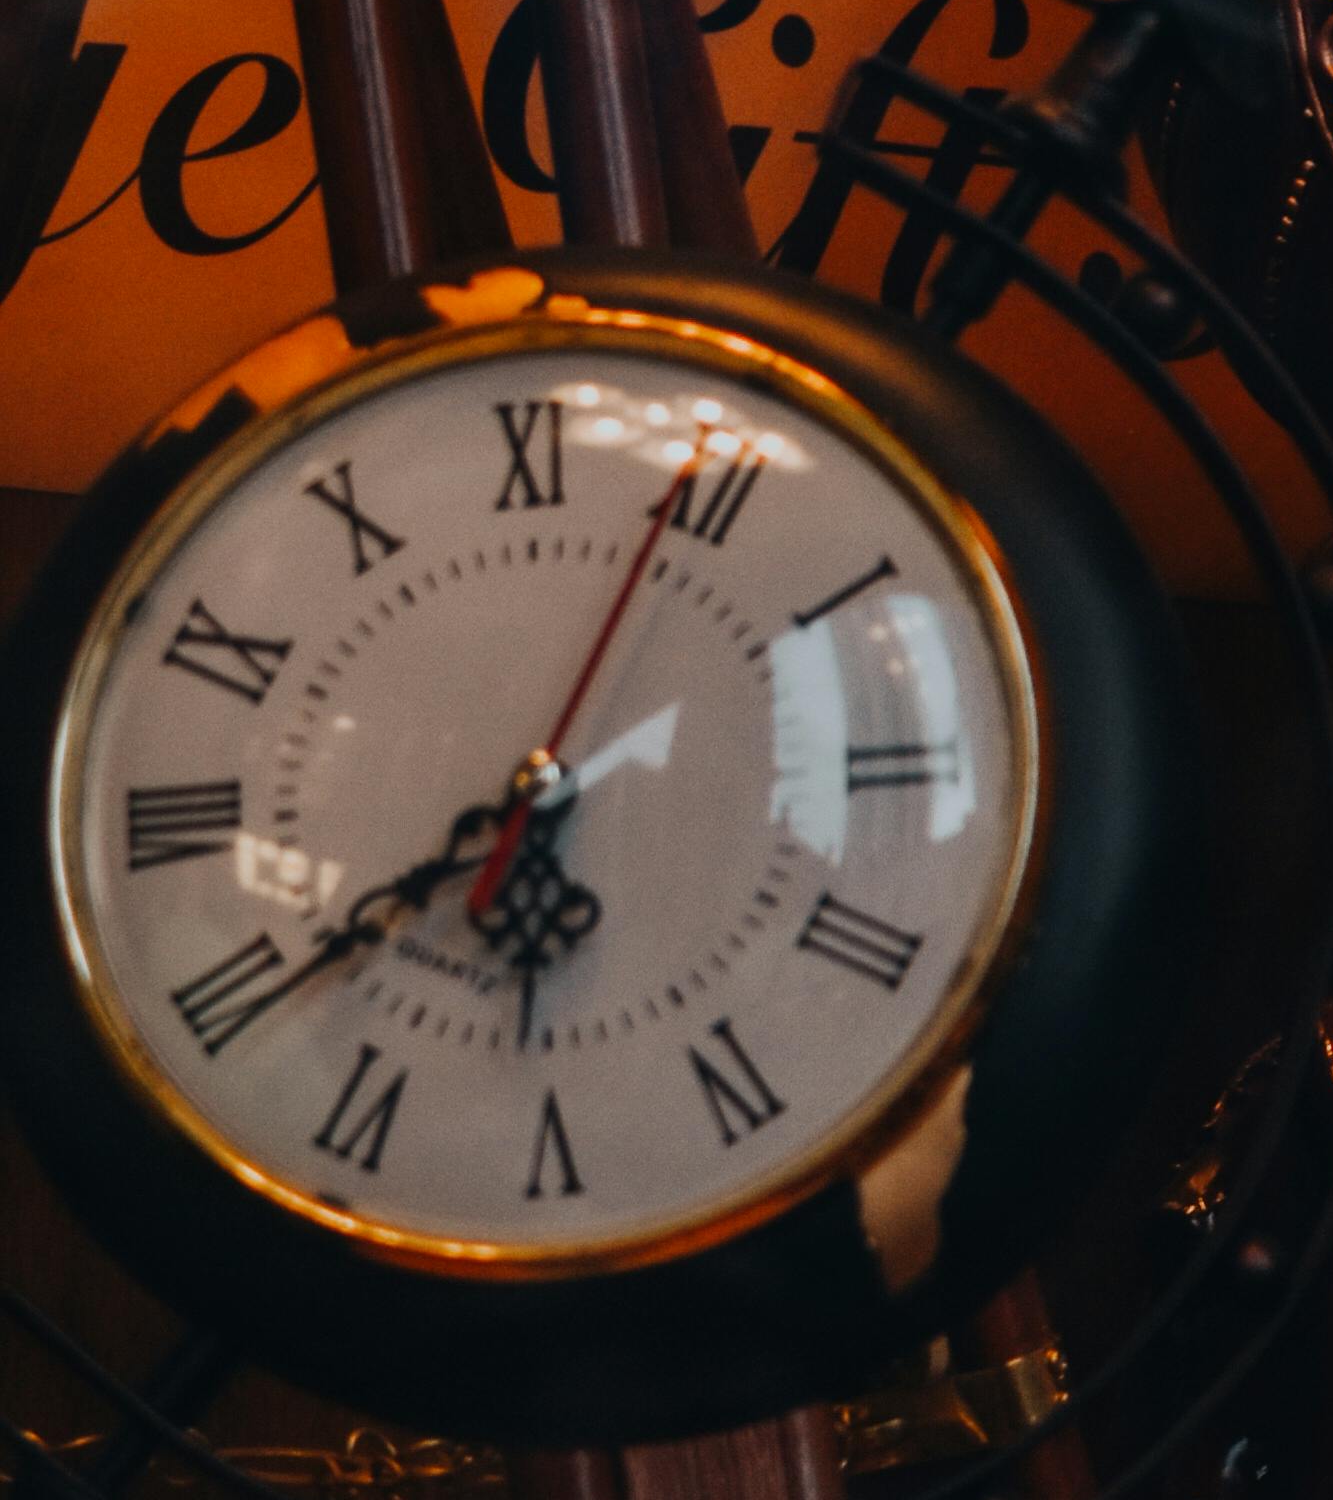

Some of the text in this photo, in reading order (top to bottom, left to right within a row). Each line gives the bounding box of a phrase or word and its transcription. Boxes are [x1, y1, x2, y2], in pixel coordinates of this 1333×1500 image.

[493, 400, 565, 512] XI
[304, 461, 405, 577] X
[791, 554, 900, 628] I
[161, 598, 294, 706] IX
[126, 780, 241, 873] VIII
[795, 890, 924, 993] III
[312, 1043, 407, 1175] VI
[688, 1018, 786, 1148] IV
[524, 1090, 585, 1201] V
